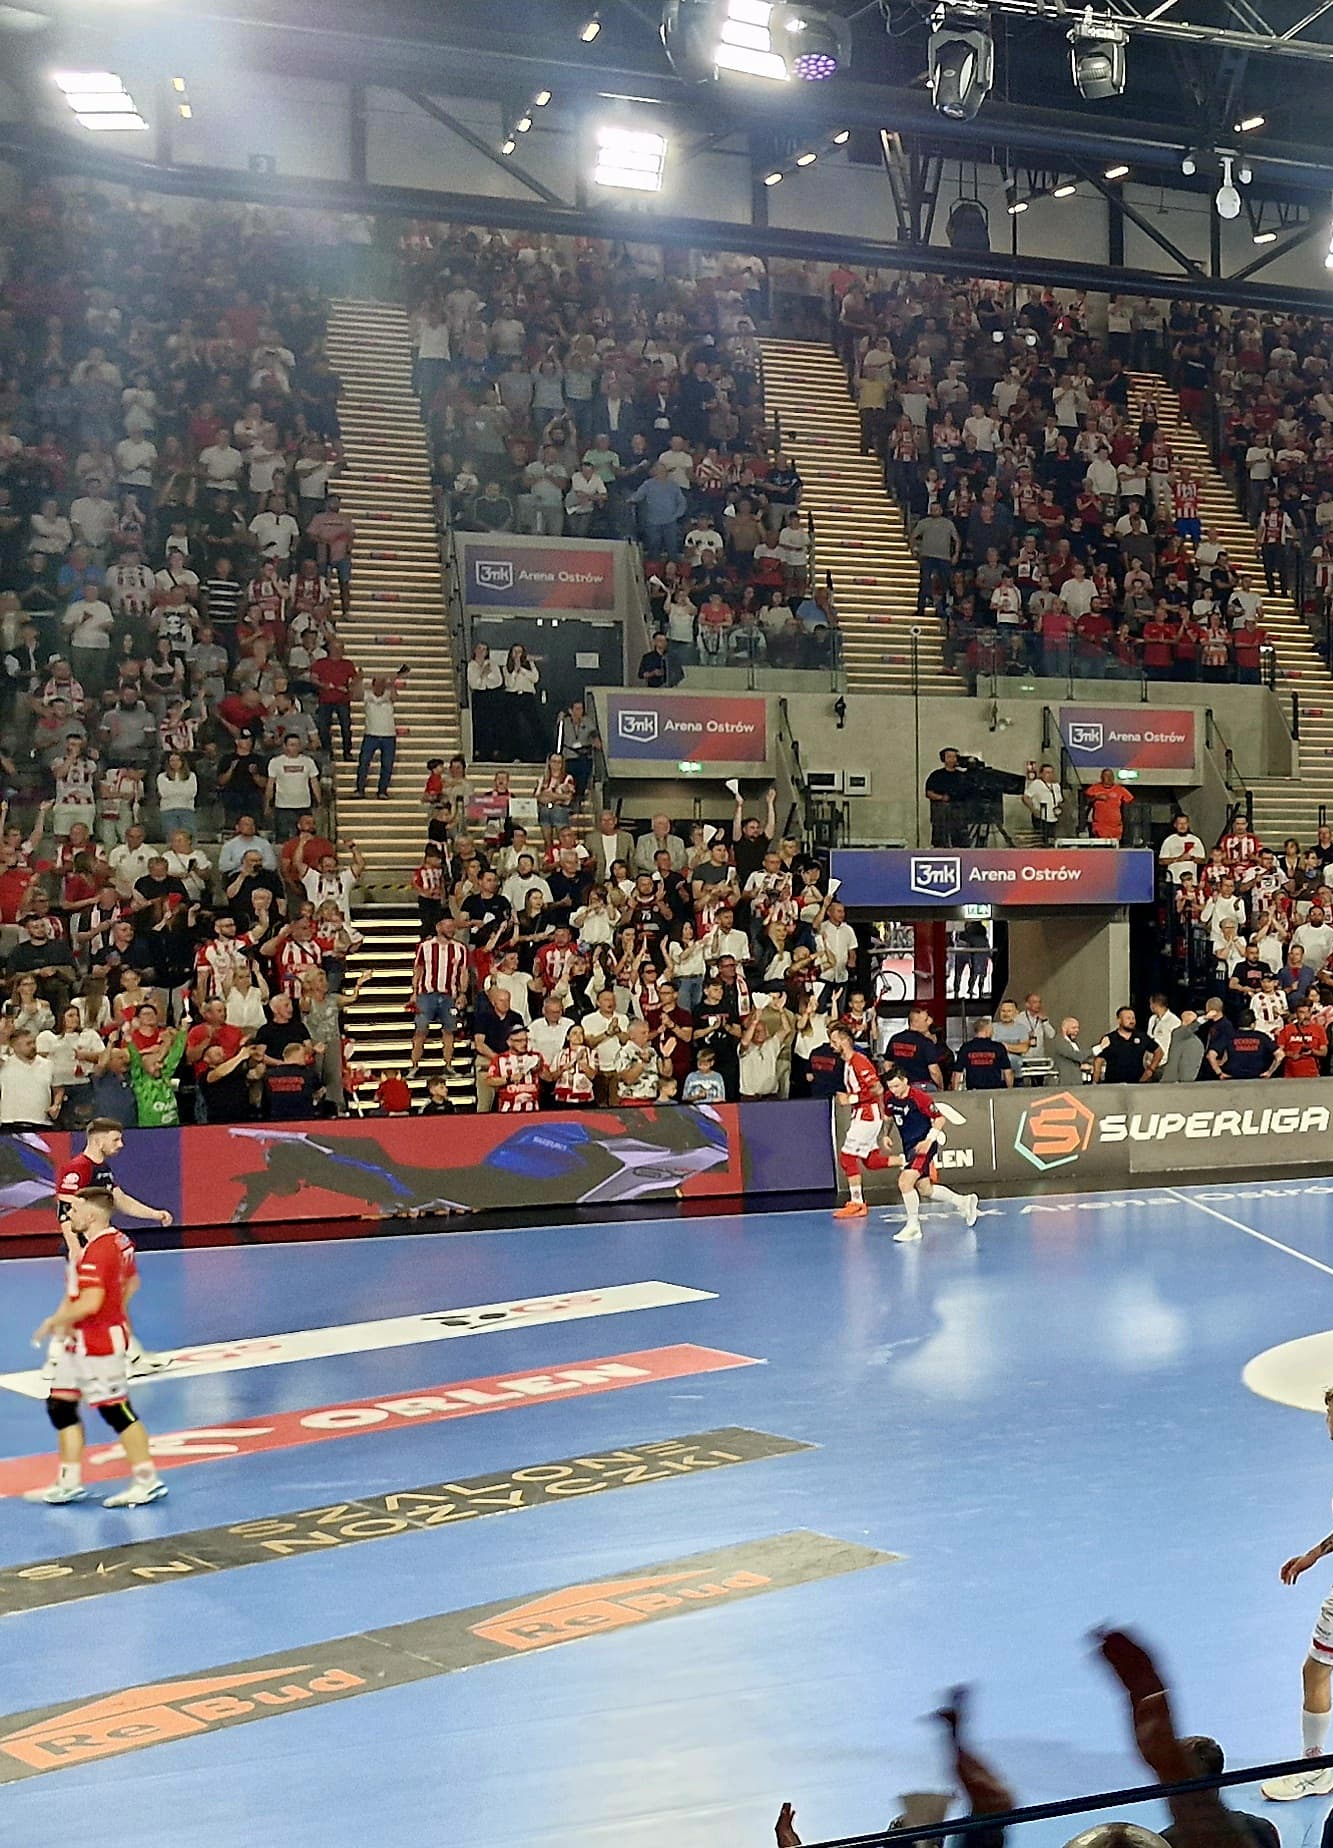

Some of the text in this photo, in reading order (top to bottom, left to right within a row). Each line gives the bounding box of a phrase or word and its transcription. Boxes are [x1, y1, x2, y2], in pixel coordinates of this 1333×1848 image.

[480, 565, 604, 583] 3mk Arena Ostrów
[622, 715, 755, 734] 3mk Arena Ostrów
[1072, 730, 1186, 744] 3mk Arena Ostrów
[916, 865, 1081, 886] 3mk Arena Ostrów
[1099, 1105, 1331, 1143] SUPERLIGA
[1019, 1196, 1180, 1215] Arena
[298, 1361, 653, 1431] ORLEN
[230, 1438, 702, 1541] SZALONE
[261, 1447, 745, 1557] NOŻYCZKI
